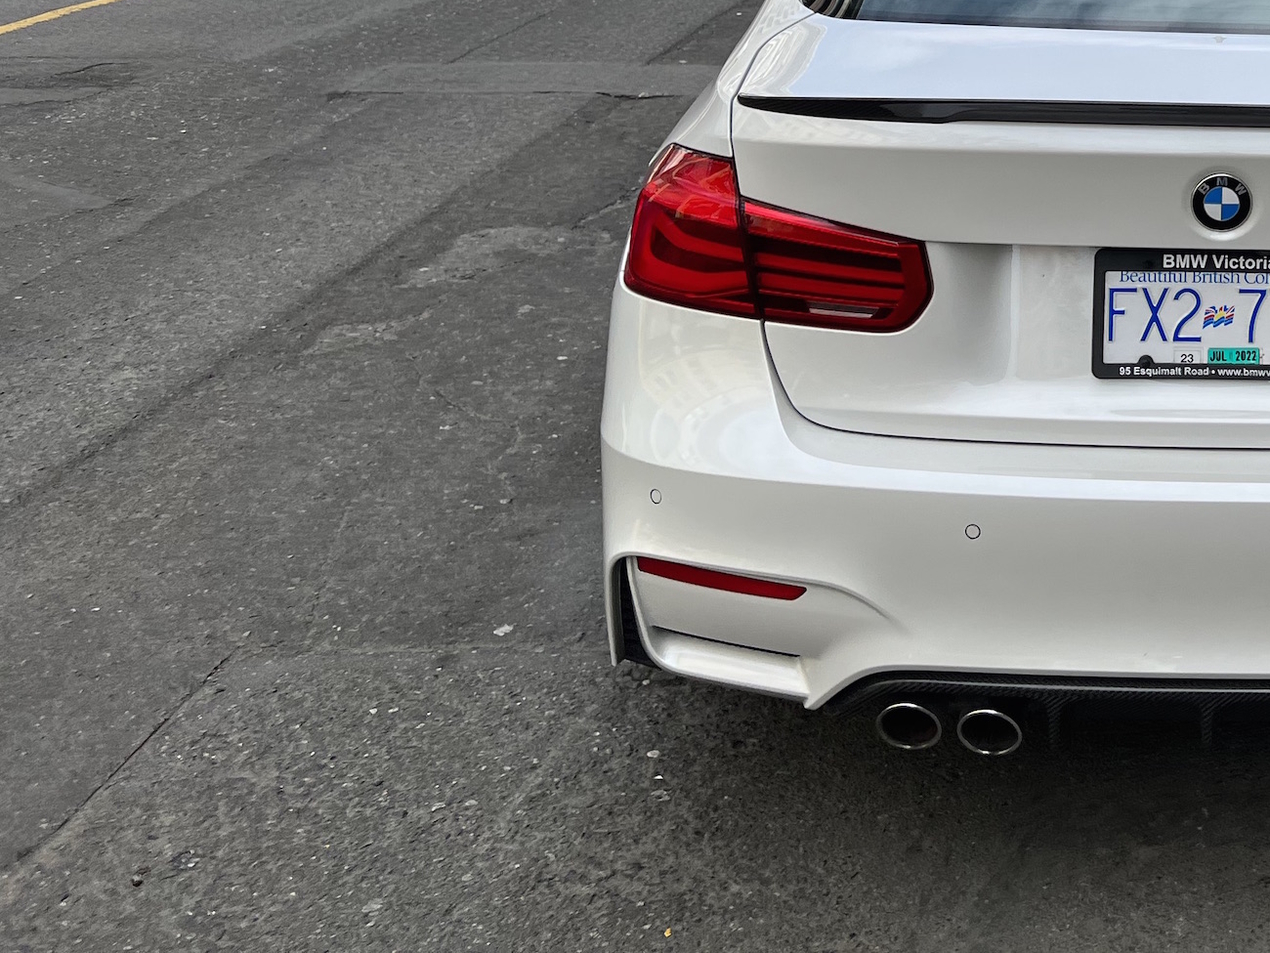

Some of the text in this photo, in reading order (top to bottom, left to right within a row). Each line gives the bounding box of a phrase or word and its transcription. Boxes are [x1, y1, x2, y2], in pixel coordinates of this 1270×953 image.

[1198, 177, 1248, 196] BMW
[1162, 254, 1208, 270] BMW
[1118, 271, 1188, 284] Beautiful
[1192, 272, 1240, 285] British
[1108, 287, 1202, 343] FX2
[1180, 353, 1194, 363] 23
[1209, 350, 1258, 363] JUL 2022
[1119, 366, 1132, 376] 95
[1133, 366, 1182, 379] Esquimalt
[1184, 367, 1210, 377] Road
